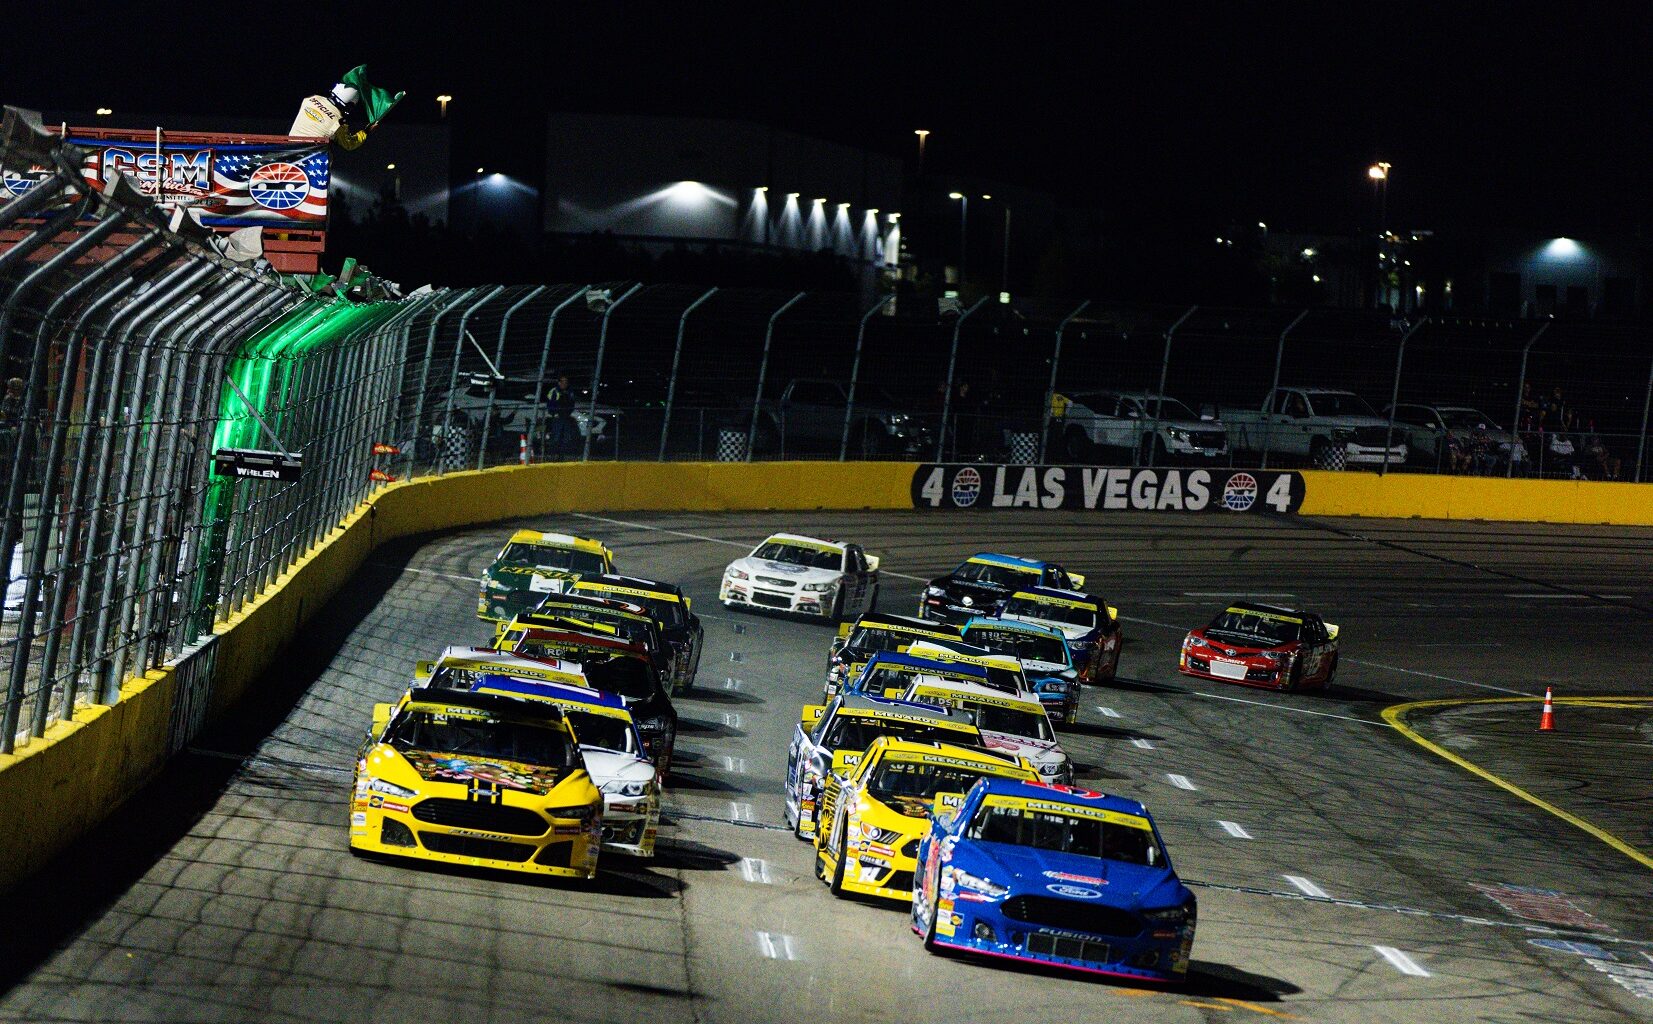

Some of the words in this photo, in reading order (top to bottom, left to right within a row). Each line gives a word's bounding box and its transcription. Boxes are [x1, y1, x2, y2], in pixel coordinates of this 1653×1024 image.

[237, 467, 279, 479] WHELEN
[921, 467, 944, 507] 4
[992, 467, 1065, 509] LAS
[1082, 468, 1211, 511] VEGAS
[1265, 474, 1291, 512] 4
[888, 624, 937, 636] MENARDS
[938, 653, 989, 666] MENARDS
[1215, 656, 1247, 665] CAMRY
[480, 665, 547, 678] MENARDS
[904, 665, 959, 677] MENARDS
[951, 693, 1011, 707] MENARDS
[874, 710, 938, 725] MENARDS
[923, 755, 996, 771] MENARDS
[1026, 802, 1106, 819] MENARDS
[1059, 886, 1090, 896] Ford
[1038, 927, 1102, 943] FUSION
